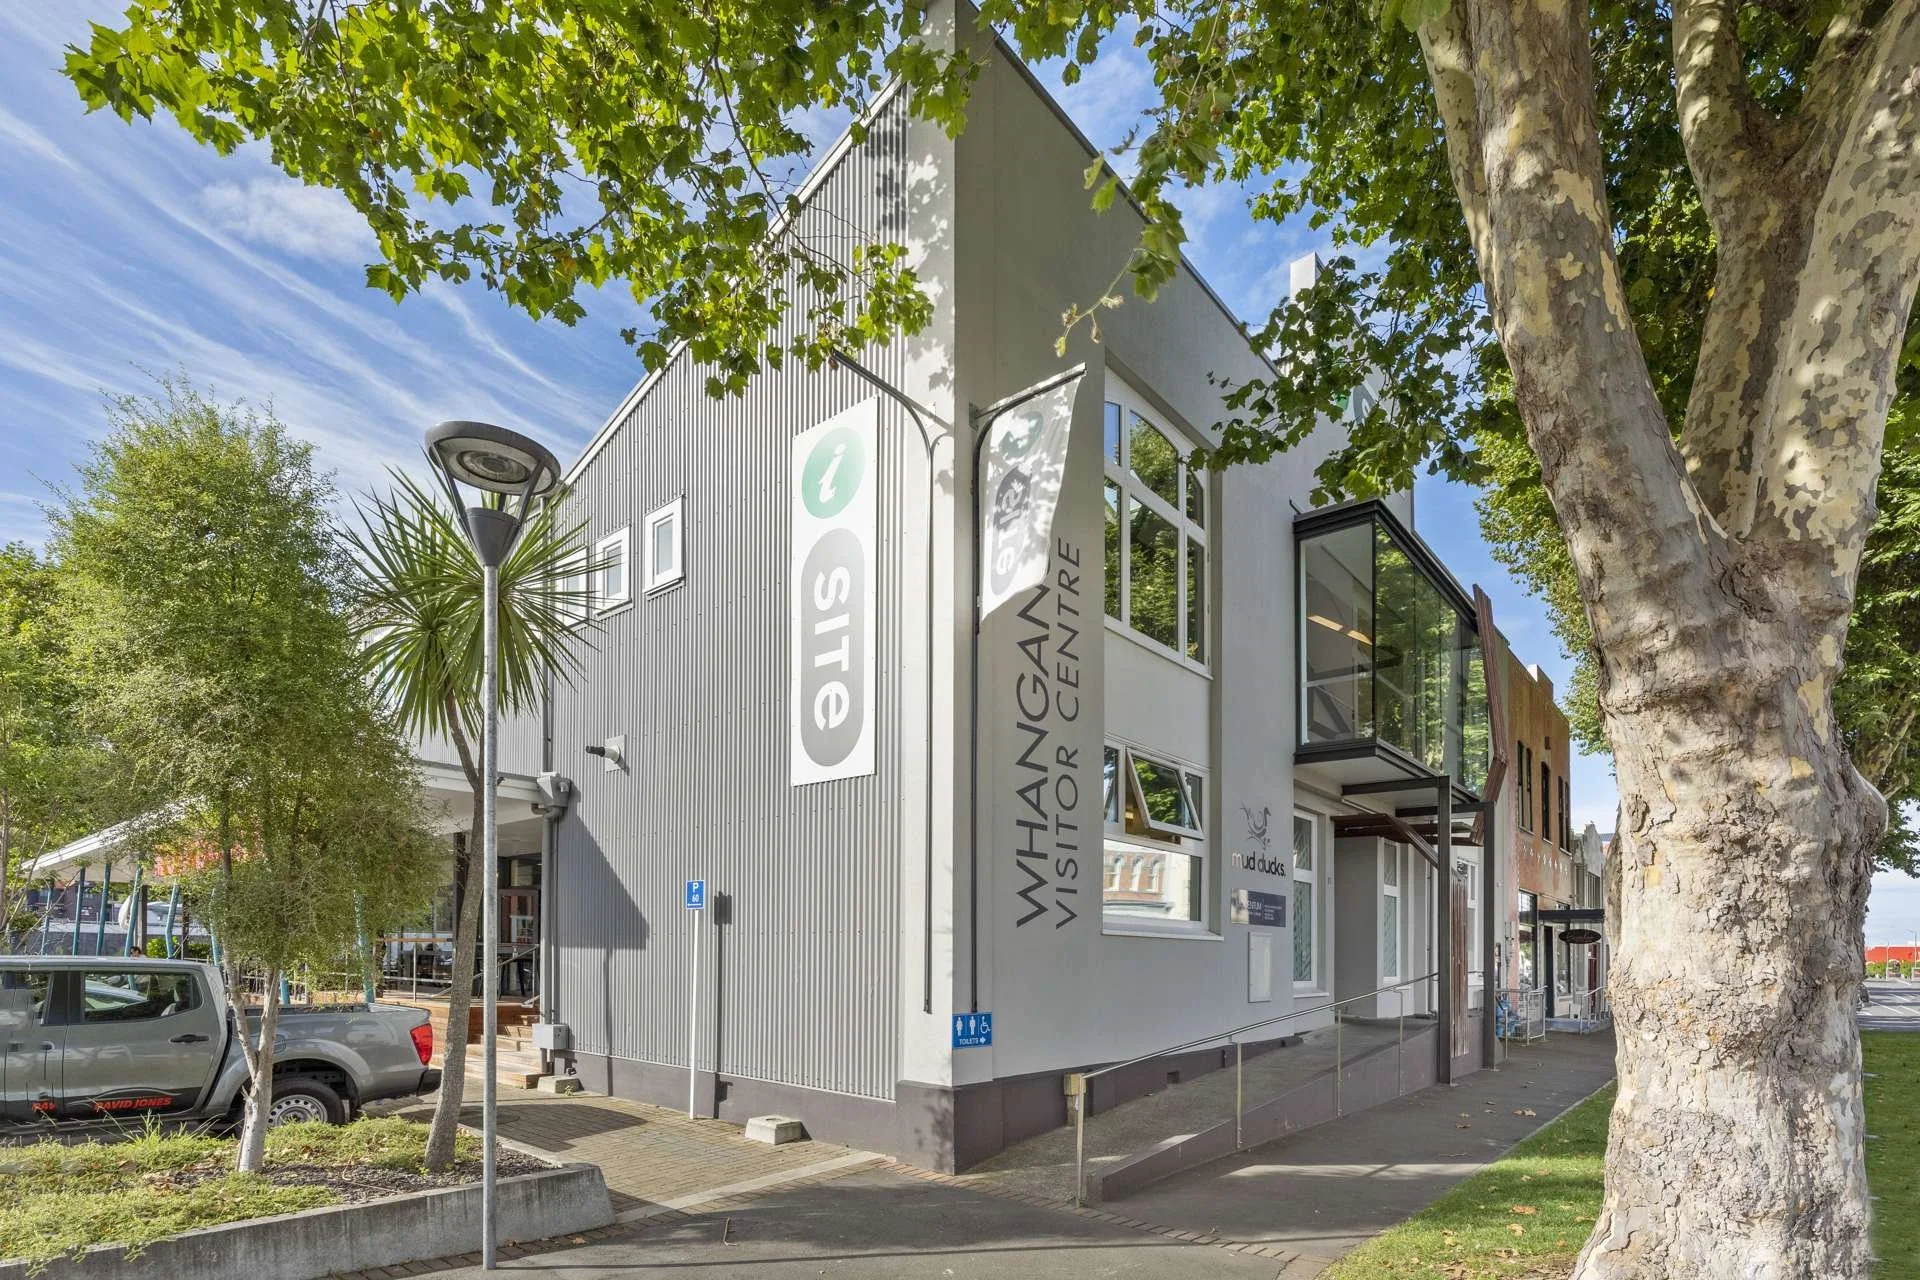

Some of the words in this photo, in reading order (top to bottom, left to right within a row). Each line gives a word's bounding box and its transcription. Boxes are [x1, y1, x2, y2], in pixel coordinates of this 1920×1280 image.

[1056, 537, 1080, 722] CENTRE
[1016, 555, 1051, 928] WHANGAN
[692, 882, 699, 893] P
[1055, 745, 1079, 930] VISITOR
[1232, 851, 1256, 871] mud
[135, 1096, 173, 1108] JONES
